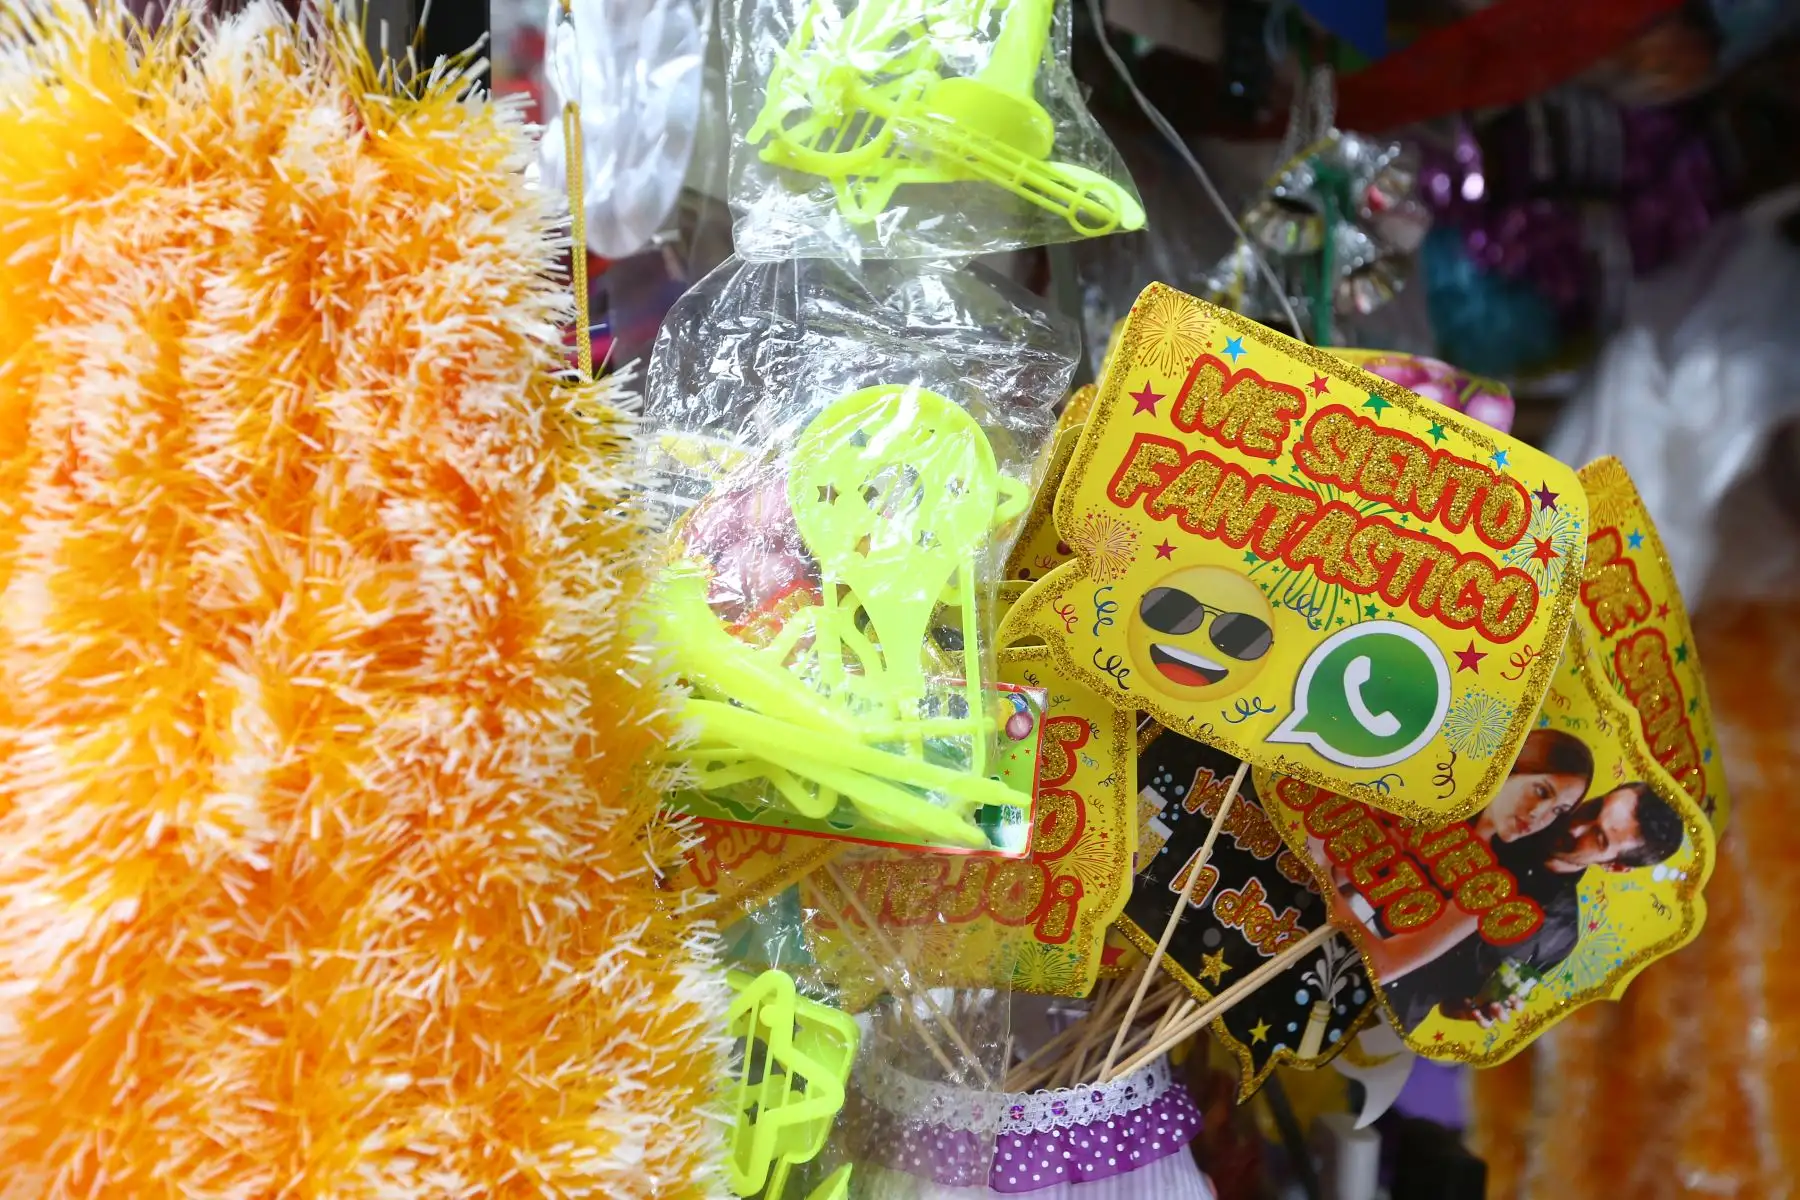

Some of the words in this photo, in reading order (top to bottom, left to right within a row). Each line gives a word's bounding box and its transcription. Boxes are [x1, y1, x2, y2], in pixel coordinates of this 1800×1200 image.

[1107, 433, 1539, 644] FANTASTICO
[1171, 353, 1306, 459] ME
[1294, 404, 1532, 550] SIENTO
[1580, 526, 1652, 637] ME
